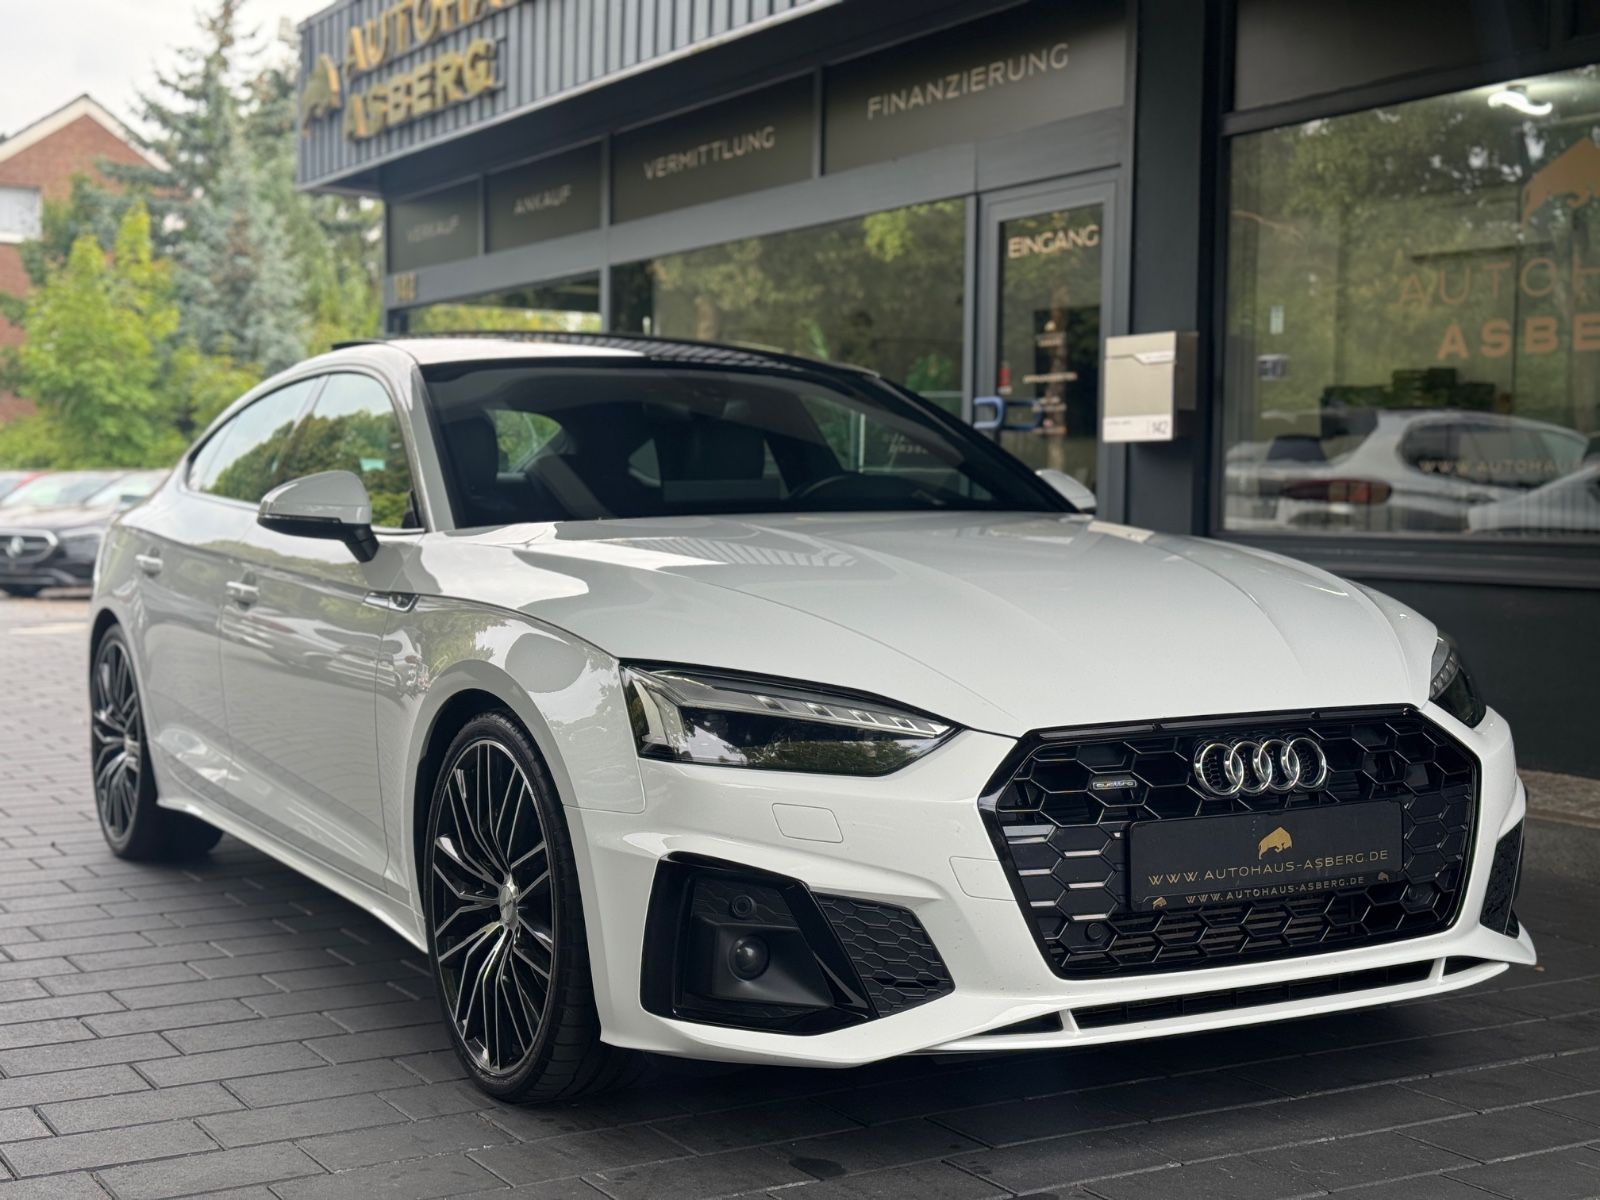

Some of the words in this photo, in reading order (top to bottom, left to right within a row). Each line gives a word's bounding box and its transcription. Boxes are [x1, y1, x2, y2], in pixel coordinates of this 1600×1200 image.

[343, 38, 496, 143] ASBERG
[866, 43, 1069, 120] FINANZIERUNG
[643, 125, 776, 181] VERMITTLUNG
[513, 184, 571, 216] ANKAUF
[1007, 225, 1100, 259] EINGANG
[1148, 849, 1389, 886] WWW.AUTOHAUS-ASBERG.DE
[1185, 876, 1365, 904] WWW.AUTOHAUS-ASBERG.DE
